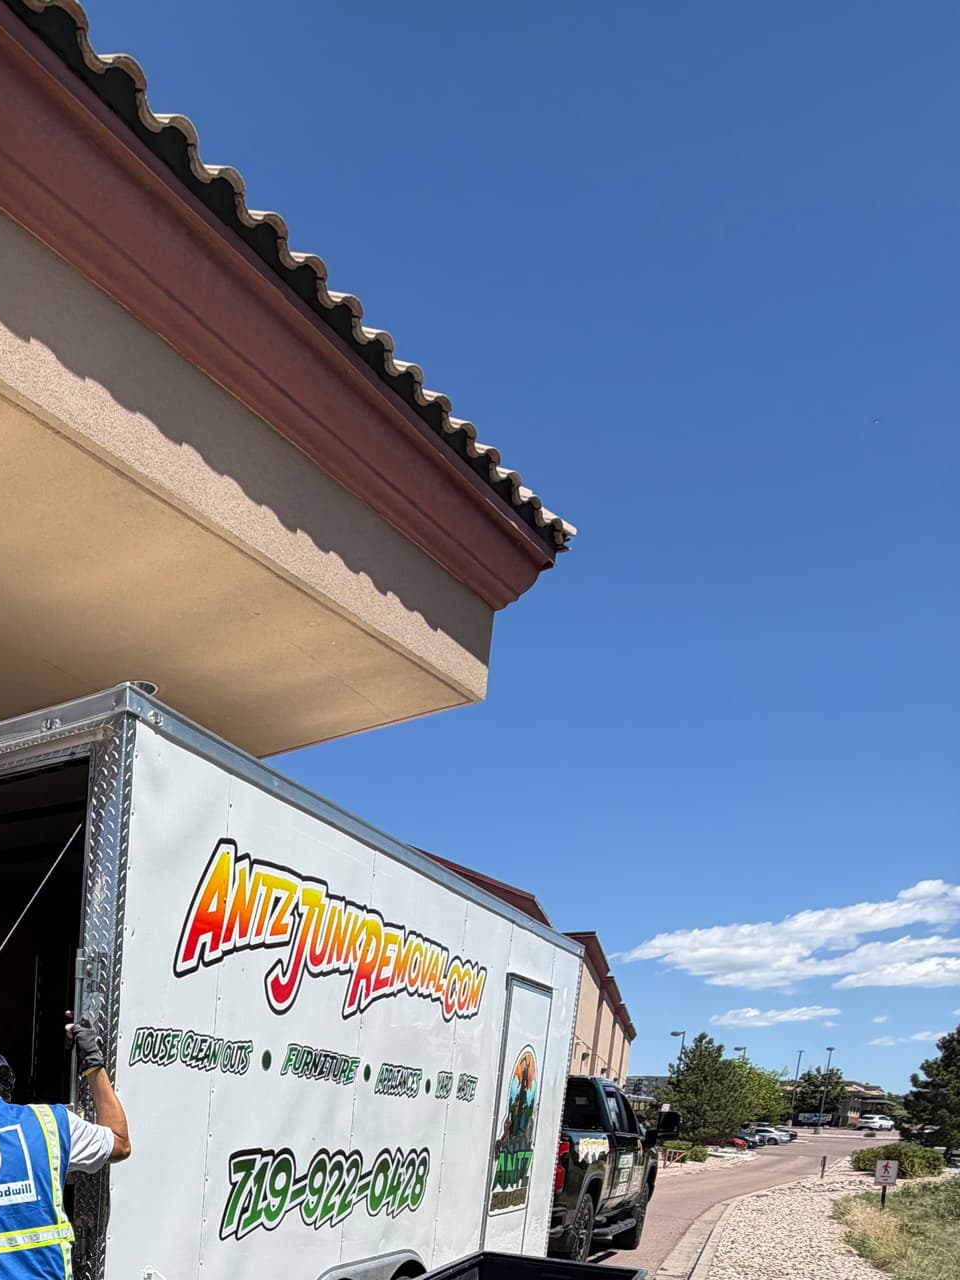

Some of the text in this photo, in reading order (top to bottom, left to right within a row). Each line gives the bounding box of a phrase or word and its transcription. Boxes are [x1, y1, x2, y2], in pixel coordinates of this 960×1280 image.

[129, 1027, 183, 1067] HOUSE
[180, 1030, 224, 1072] CLEAN
[221, 1040, 253, 1075] OUTS
[280, 1043, 360, 1086] FURNITURE
[219, 1147, 430, 1241] 719-922-0428
